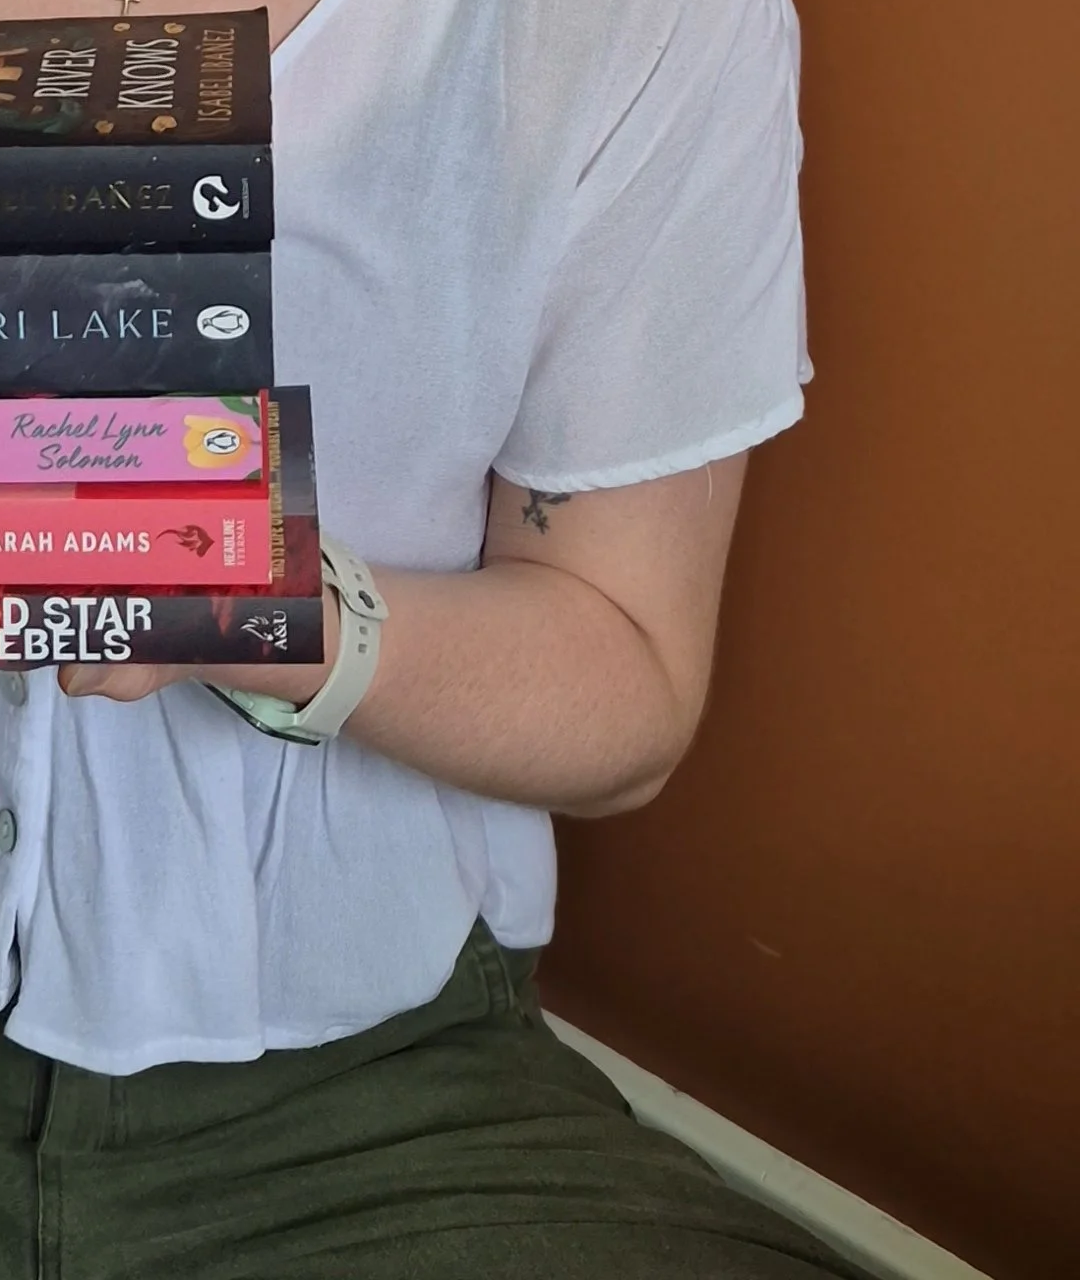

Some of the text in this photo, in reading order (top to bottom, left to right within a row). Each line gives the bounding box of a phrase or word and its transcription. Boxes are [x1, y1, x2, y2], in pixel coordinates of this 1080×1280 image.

[33, 47, 98, 98] RIVER
[117, 38, 180, 110] KNOWS
[196, 75, 234, 123] ISABEL
[50, 180, 175, 211] IBAÑEZ
[51, 307, 174, 340] LAKE
[10, 411, 168, 443] Rachel Lynn
[36, 442, 143, 472] Solomon
[63, 530, 152, 553] ADAMS
[223, 517, 236, 567] HEADLINE
[42, 596, 153, 632] STAR
[272, 609, 289, 651] A&U
